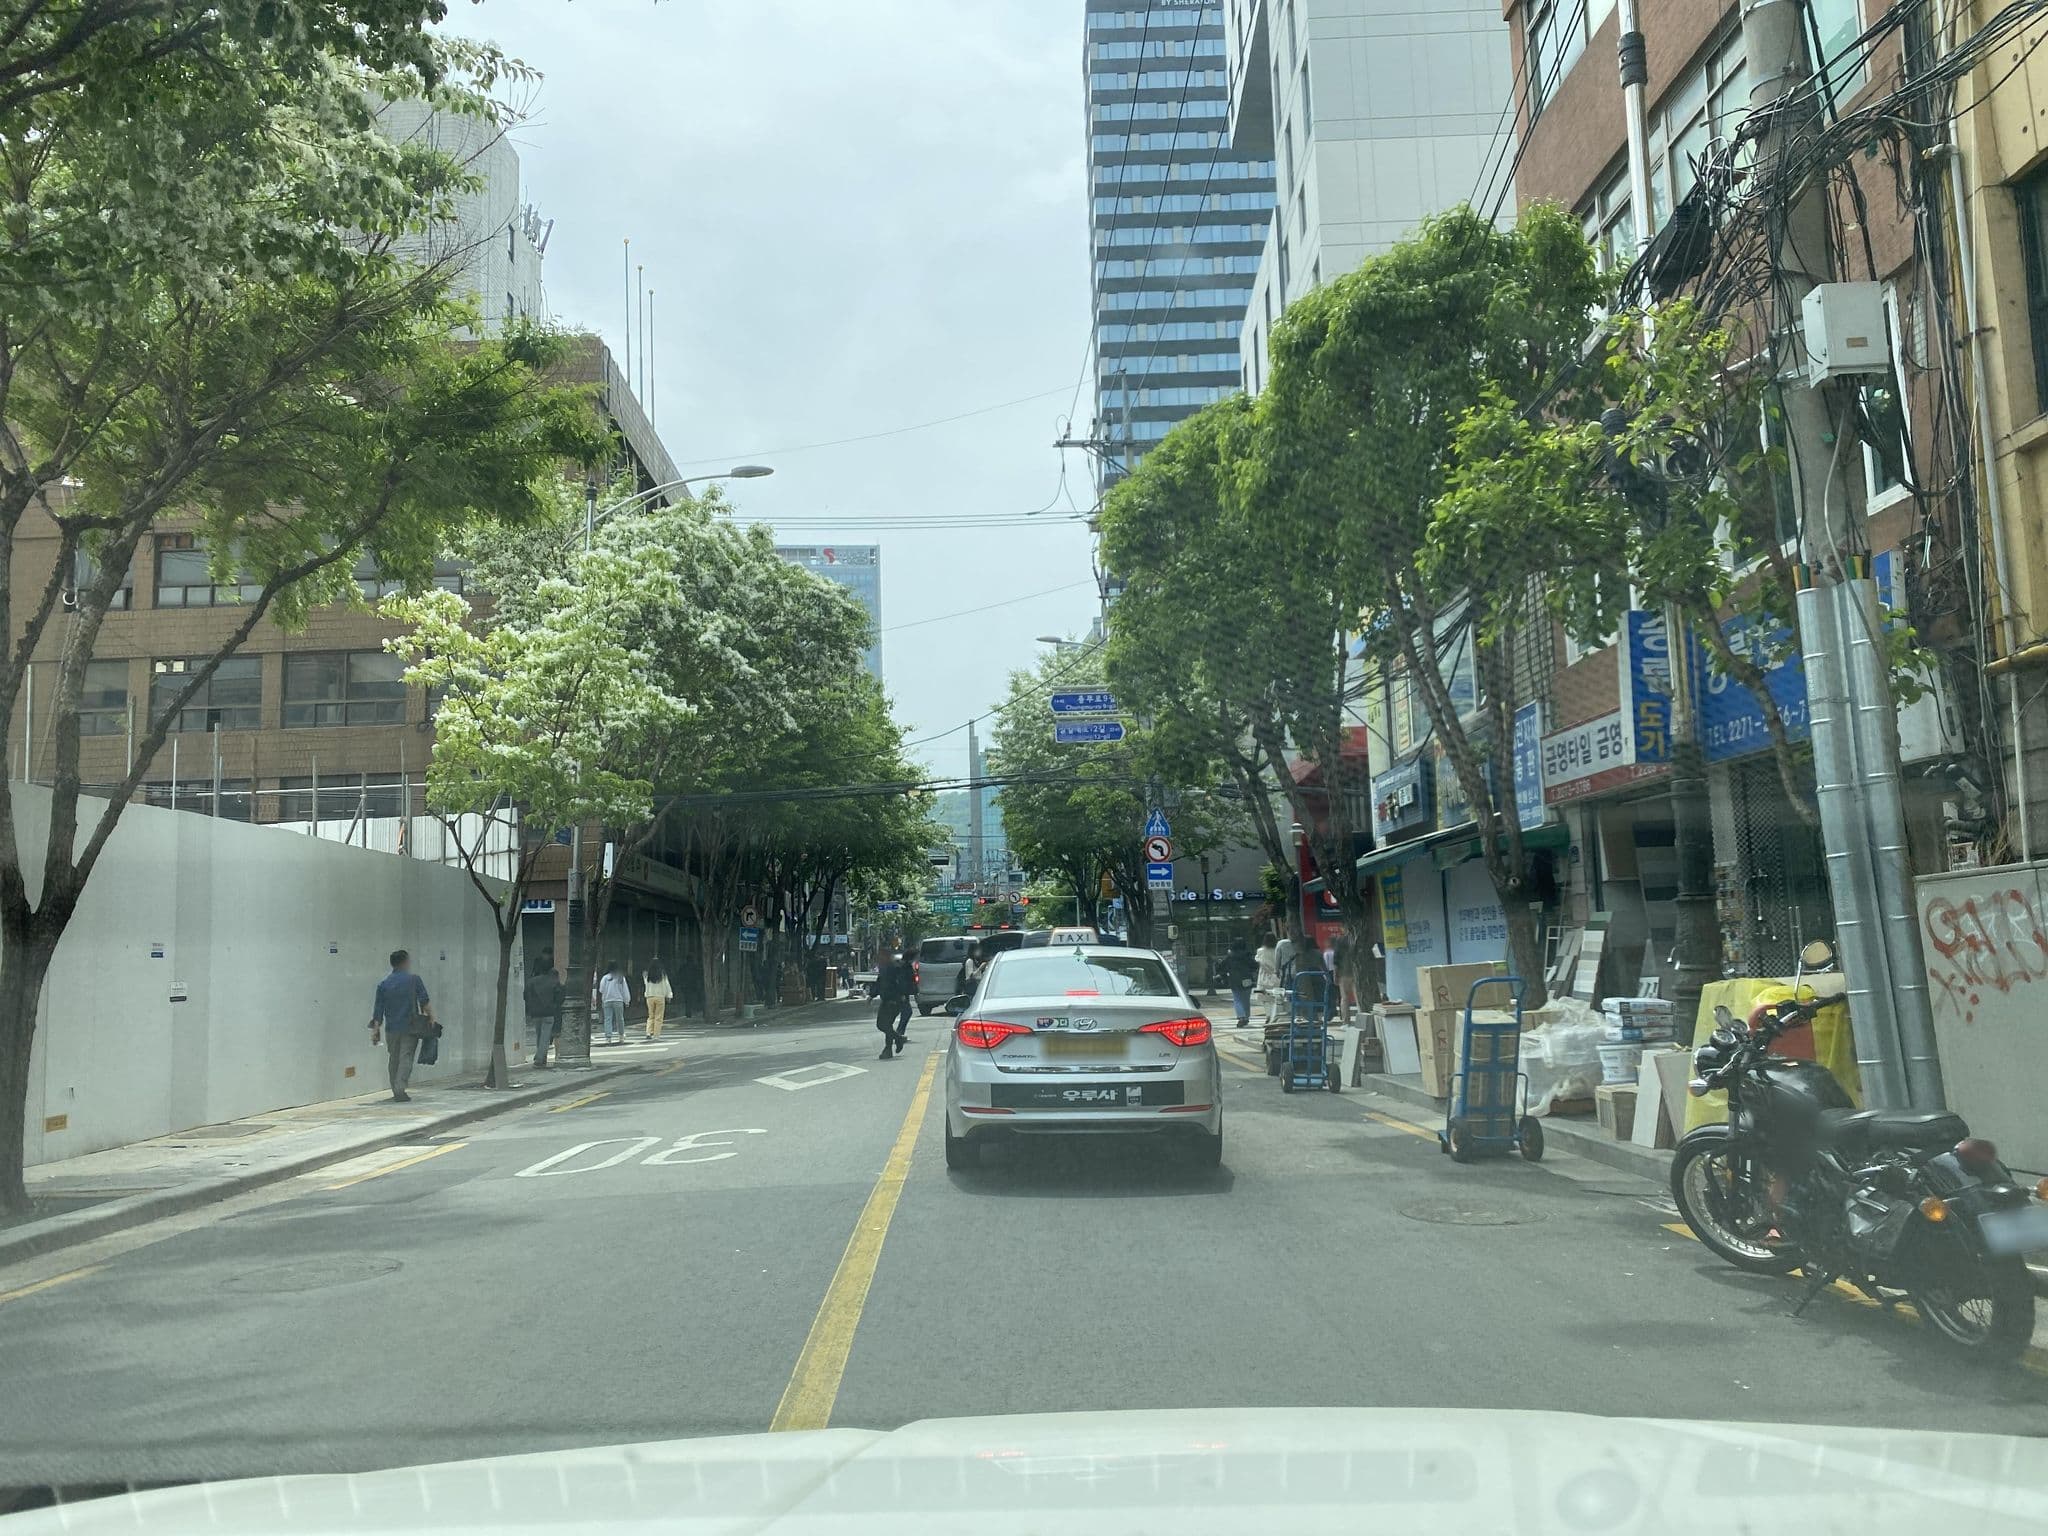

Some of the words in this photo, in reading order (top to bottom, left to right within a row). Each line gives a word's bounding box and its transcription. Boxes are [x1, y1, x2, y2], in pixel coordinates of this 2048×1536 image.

[1546, 732, 1592, 776] 금영타일
[1058, 933, 1090, 943] TAXI
[1062, 1089, 1119, 1101] 우루사
